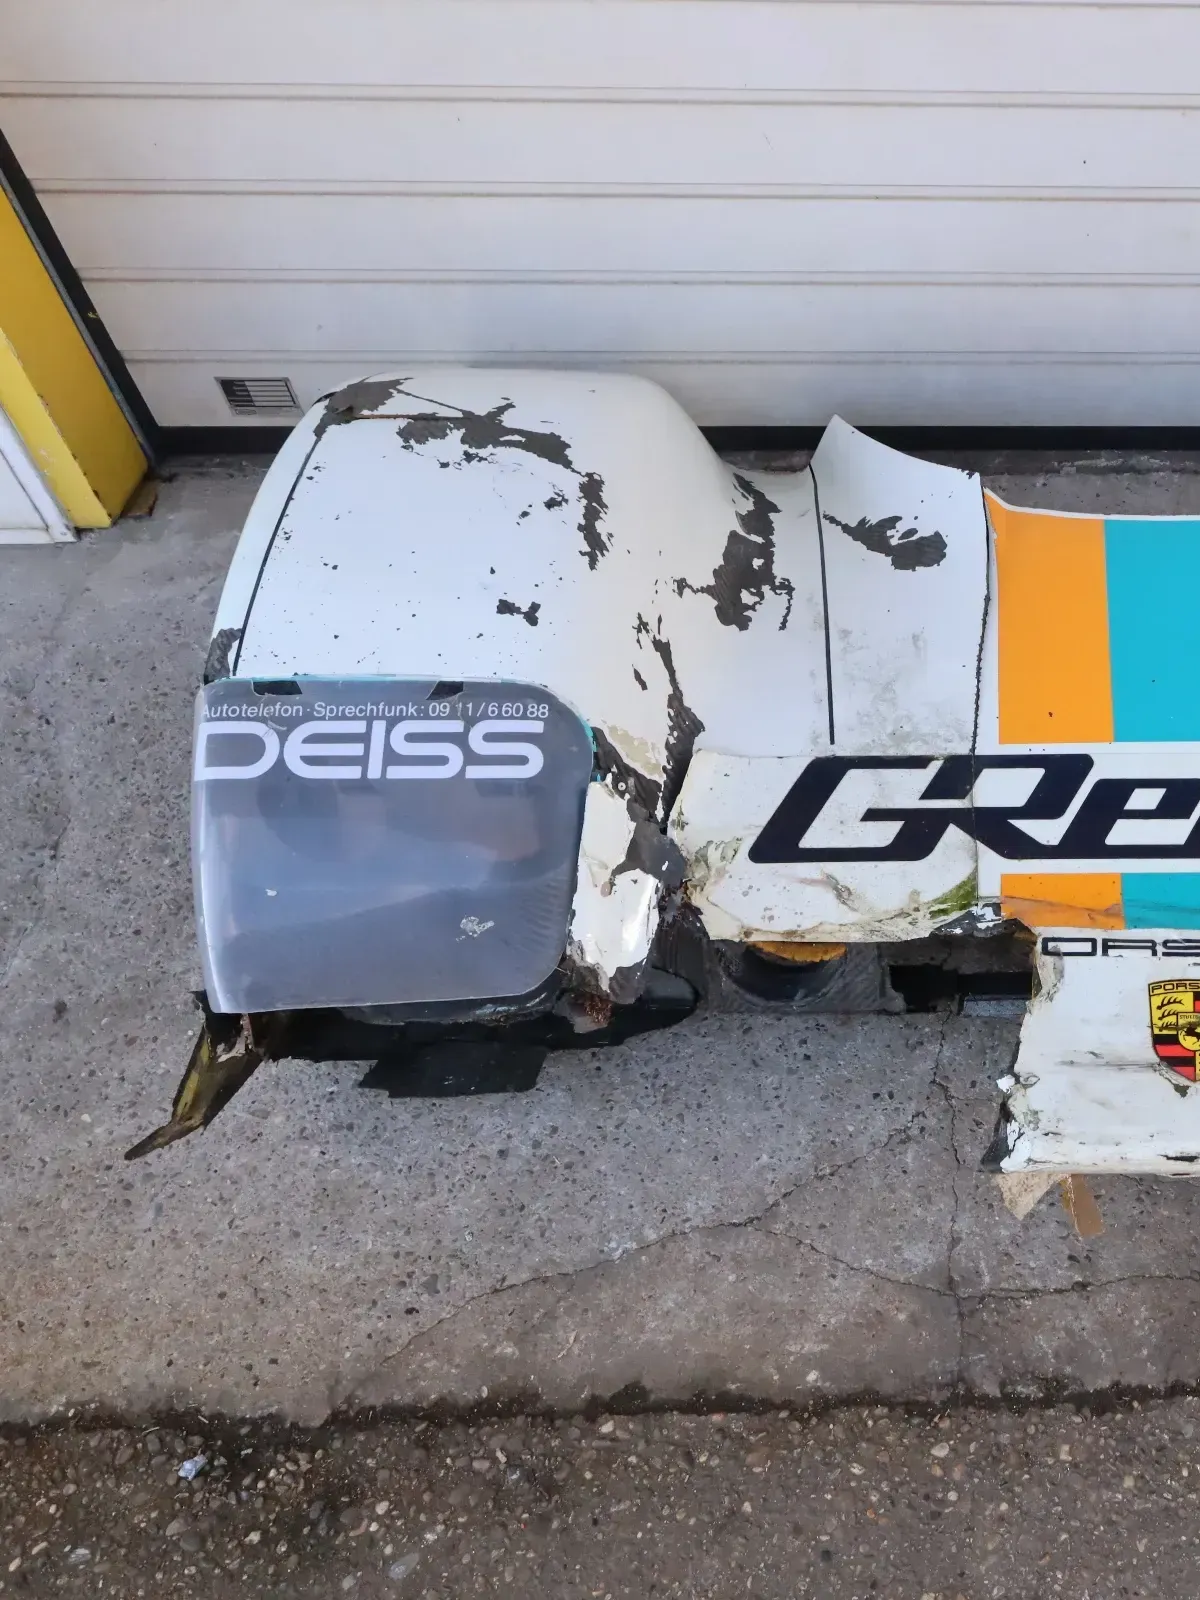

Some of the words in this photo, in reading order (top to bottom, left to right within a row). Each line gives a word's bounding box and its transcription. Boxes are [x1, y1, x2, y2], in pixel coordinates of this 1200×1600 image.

[202, 701, 303, 718] Autotelefon
[313, 701, 424, 720] Sprechfunk:
[194, 720, 544, 782] DEISS
